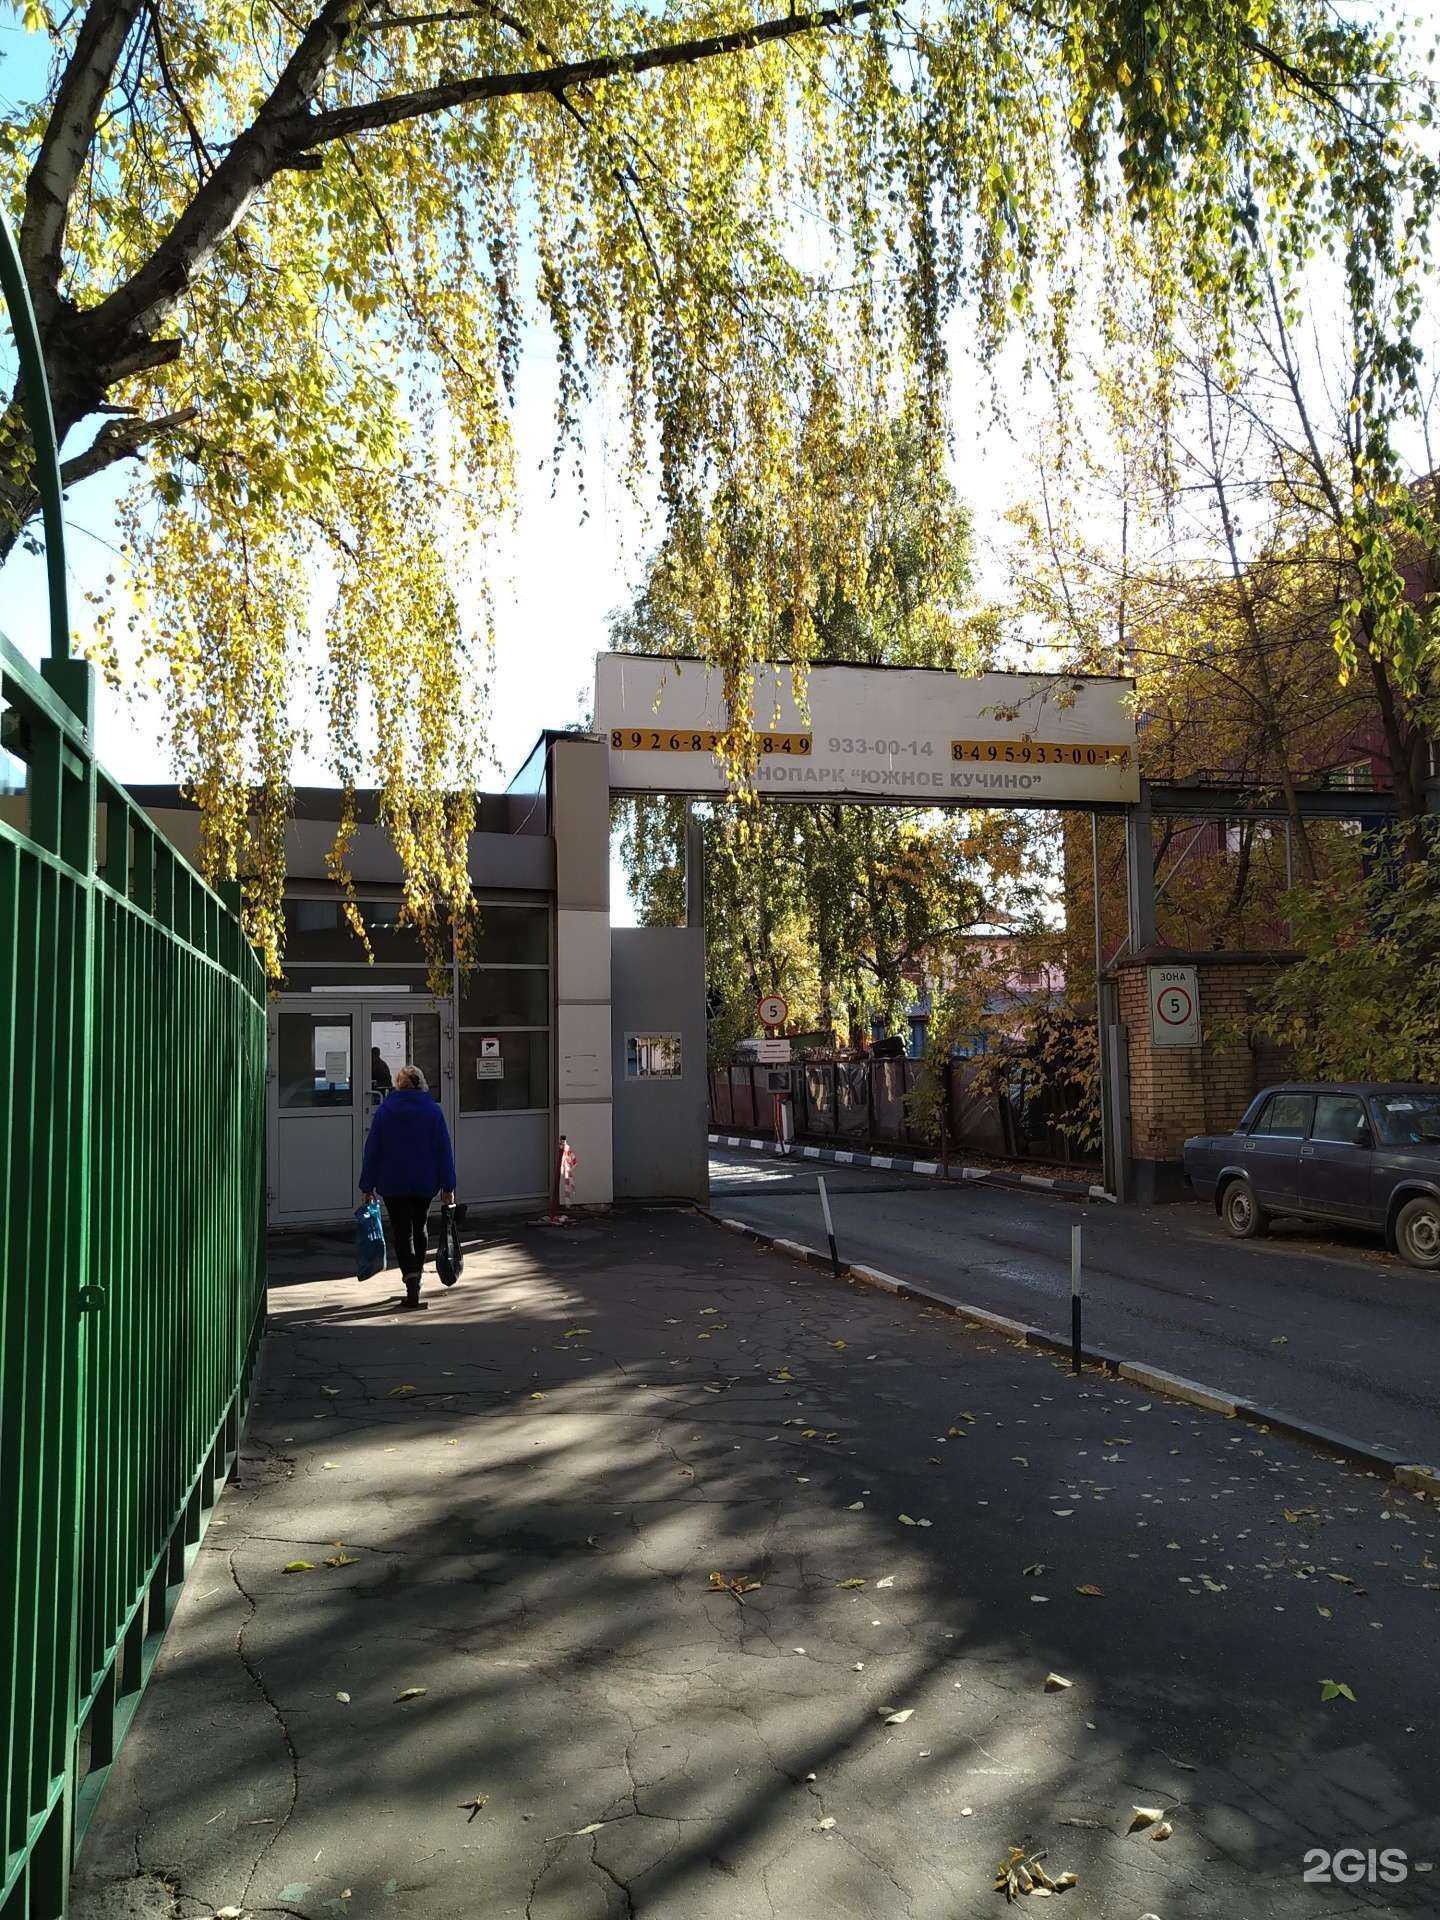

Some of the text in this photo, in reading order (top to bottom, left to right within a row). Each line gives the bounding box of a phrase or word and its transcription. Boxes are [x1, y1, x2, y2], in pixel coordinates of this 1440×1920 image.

[827, 737, 935, 756] 933-00-14
[714, 766, 845, 783] ТНОПАРК
[950, 773, 1042, 789] КУЧИНО”
[1160, 972, 1186, 981] ЗОНА
[769, 1005, 778, 1017] 5
[1171, 998, 1180, 1013] 5
